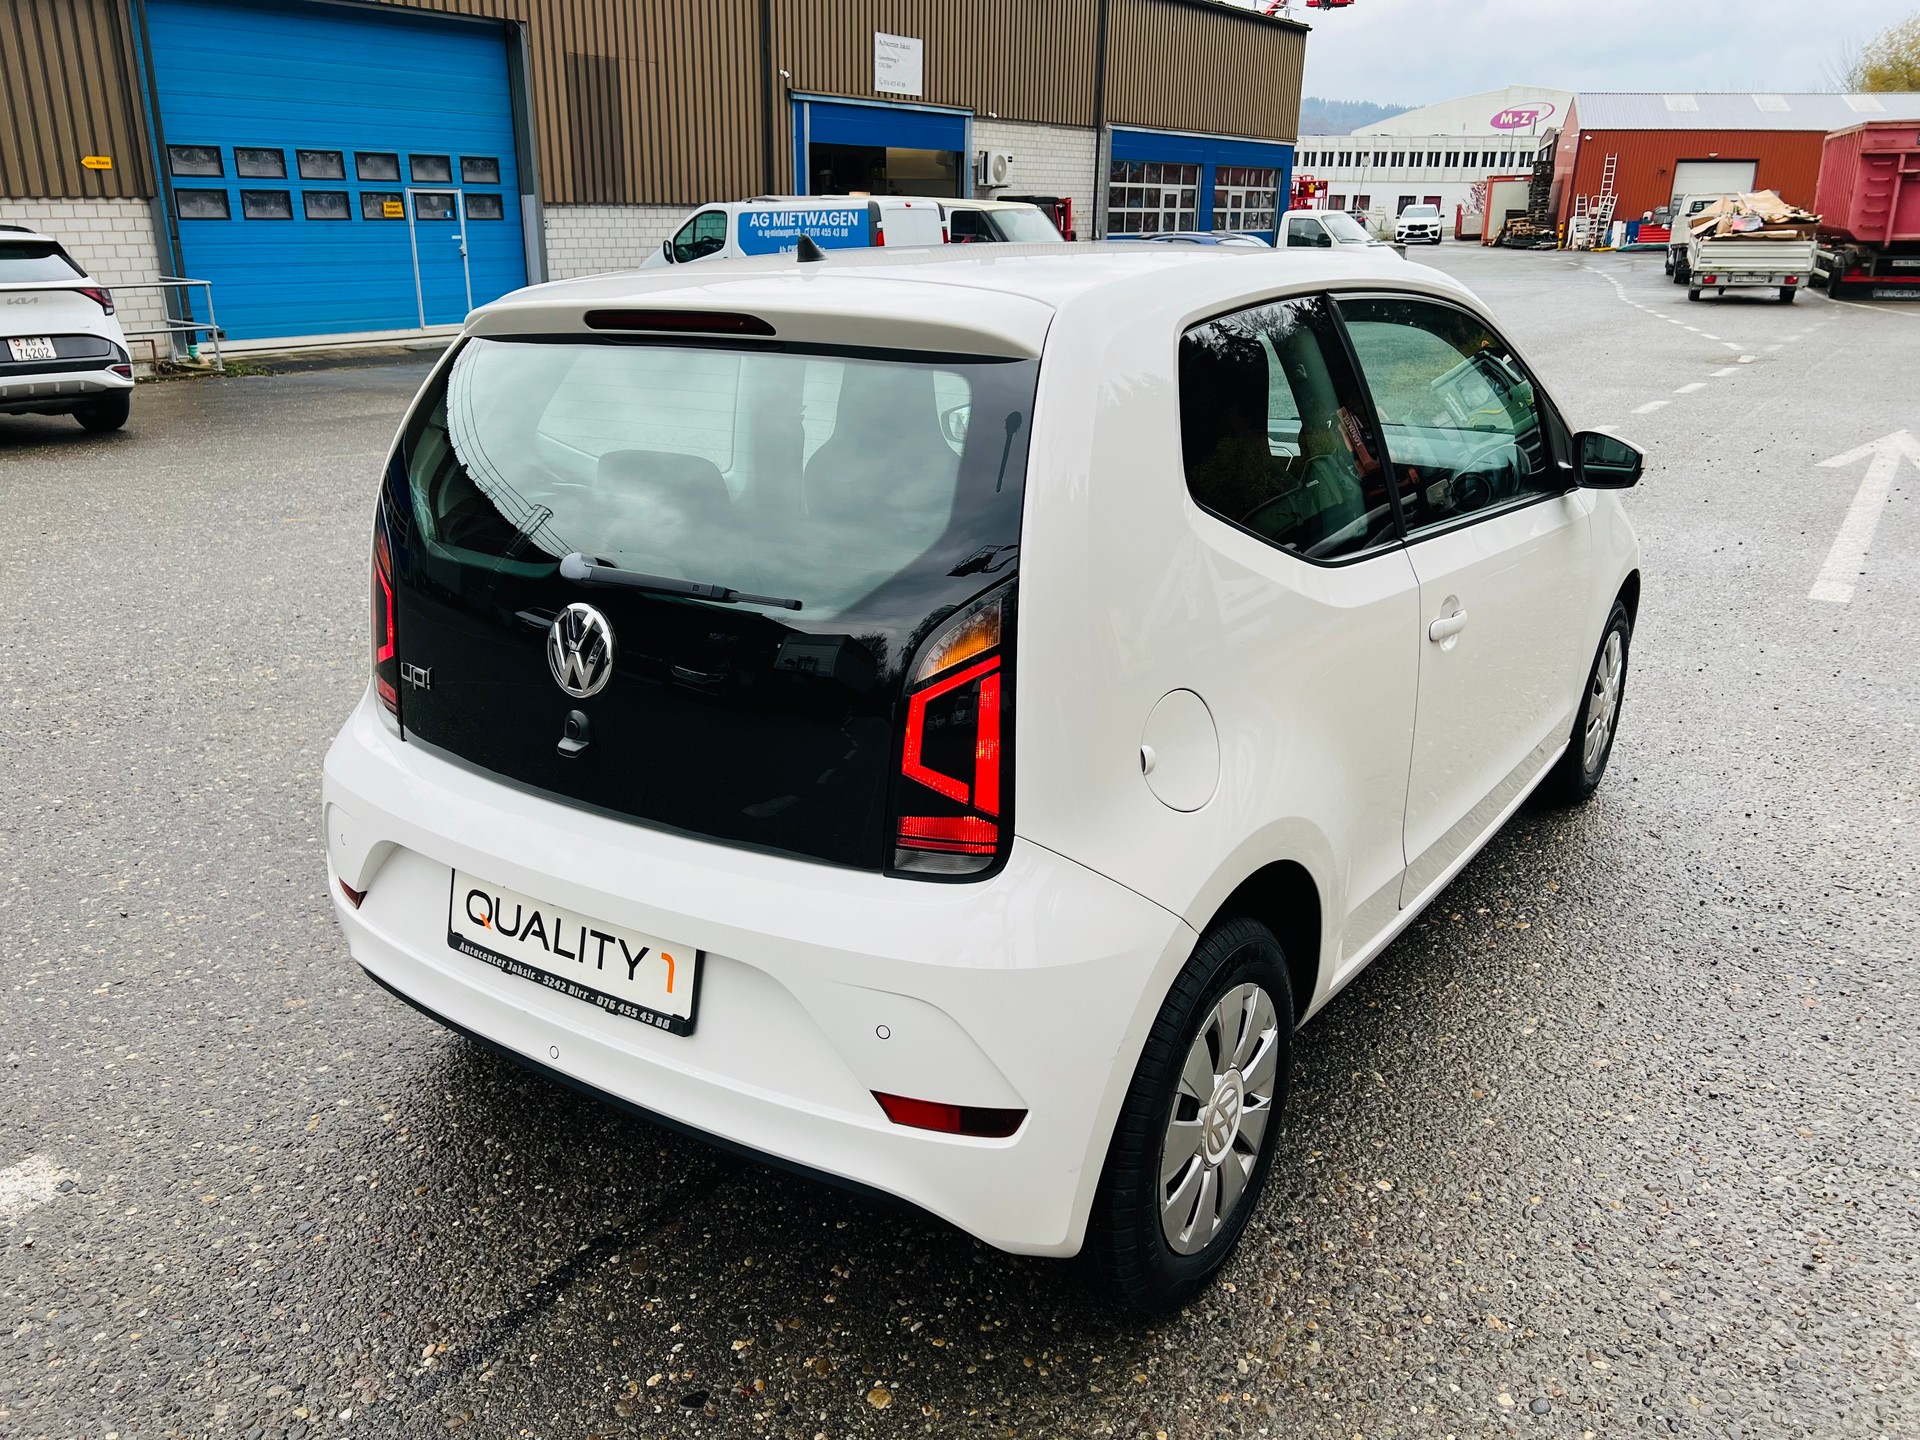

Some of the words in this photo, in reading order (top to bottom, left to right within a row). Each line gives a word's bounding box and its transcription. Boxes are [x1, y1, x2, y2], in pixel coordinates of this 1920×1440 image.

[749, 212, 770, 227] AG
[772, 211, 859, 227] MIETWAGEN
[821, 228, 831, 236] 455
[17, 347, 52, 360] 74202
[400, 661, 433, 691] up!
[466, 889, 650, 981] QUALITY
[660, 952, 675, 994] 1
[458, 941, 507, 969] Autocenter
[507, 960, 536, 981] Jaksic
[542, 975, 567, 993] 5242
[568, 984, 590, 1001] Birr
[596, 995, 616, 1012] 076
[617, 1001, 638, 1018] 455
[639, 1008, 654, 1024] 43
[655, 1014, 671, 1030] 88
